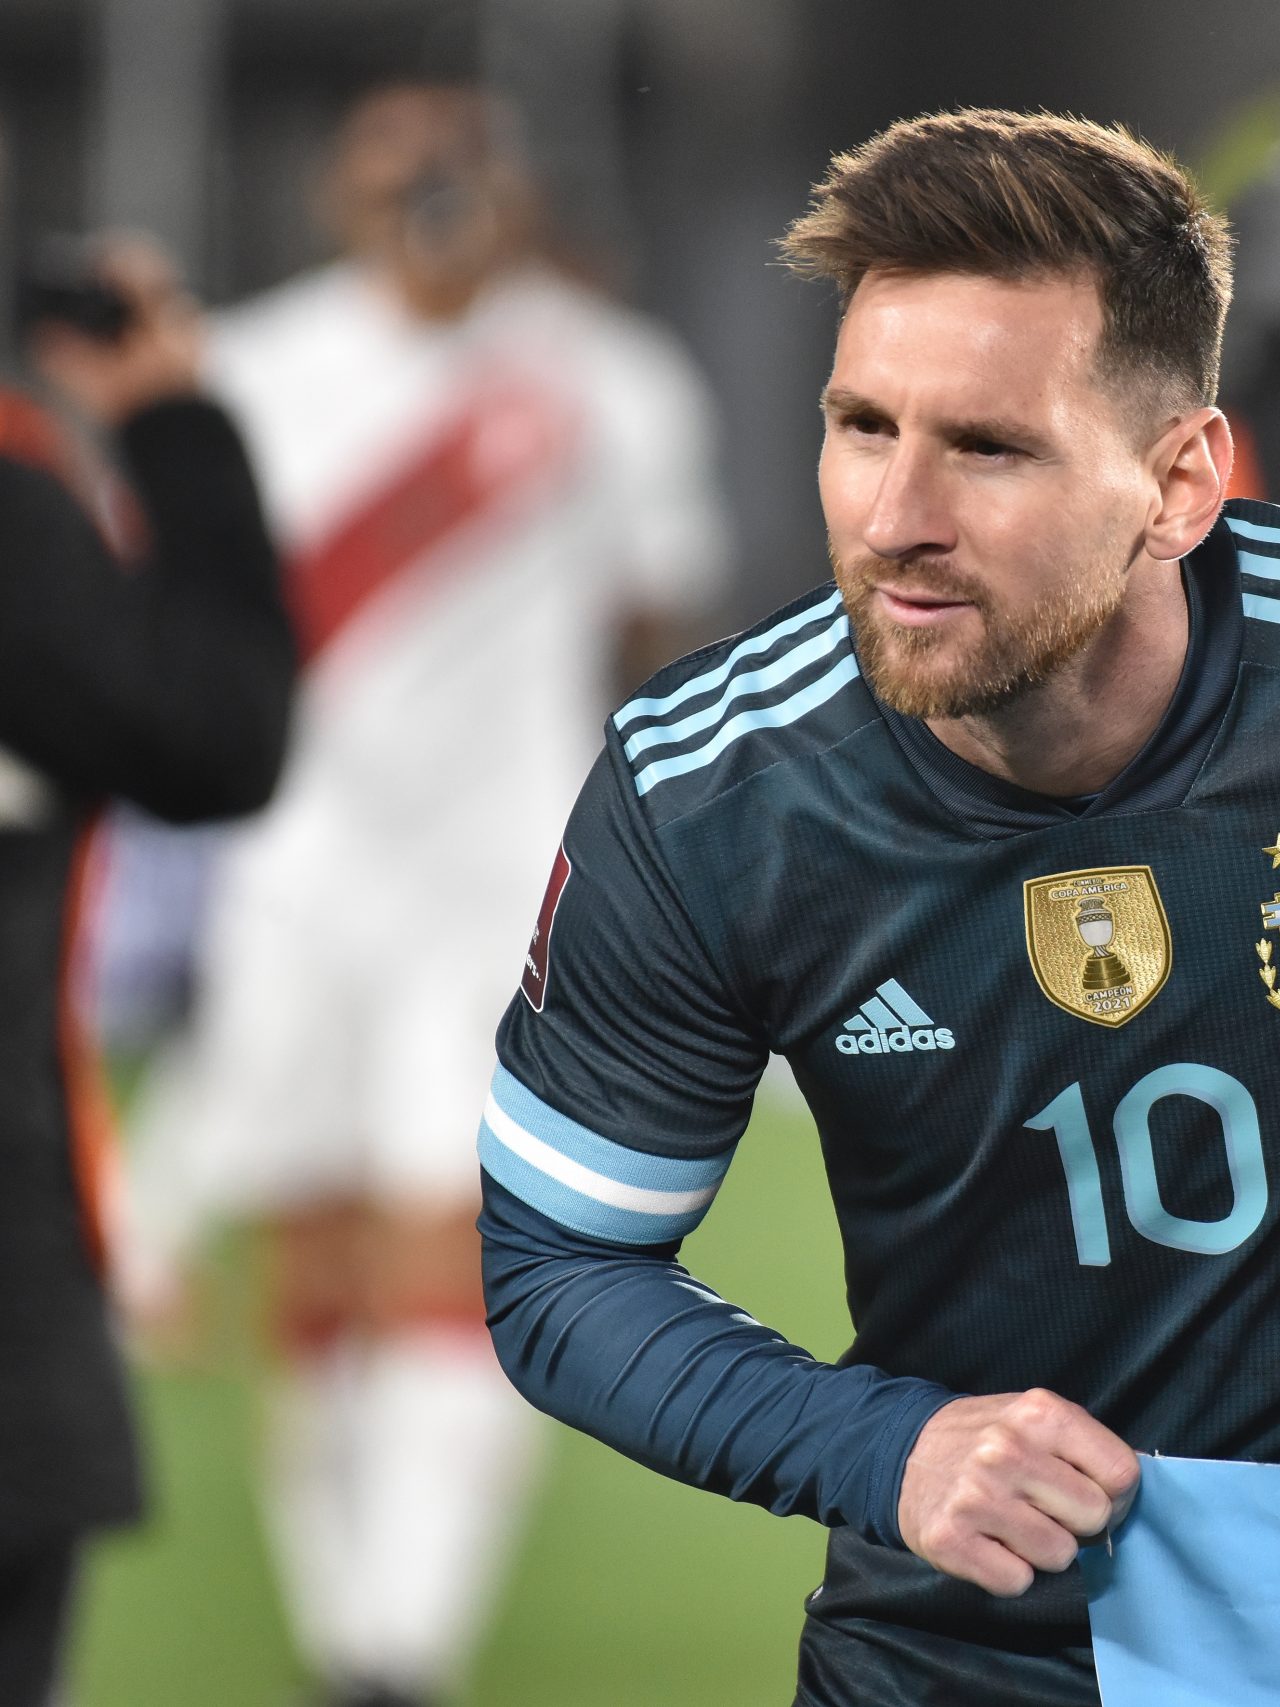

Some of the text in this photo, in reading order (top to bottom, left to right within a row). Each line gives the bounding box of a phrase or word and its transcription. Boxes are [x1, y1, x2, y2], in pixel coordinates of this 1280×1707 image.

[1052, 889, 1080, 899] COPA
[1092, 996, 1131, 1013] 2021
[835, 1024, 956, 1055] adidas
[1022, 1062, 1269, 1267] 10
